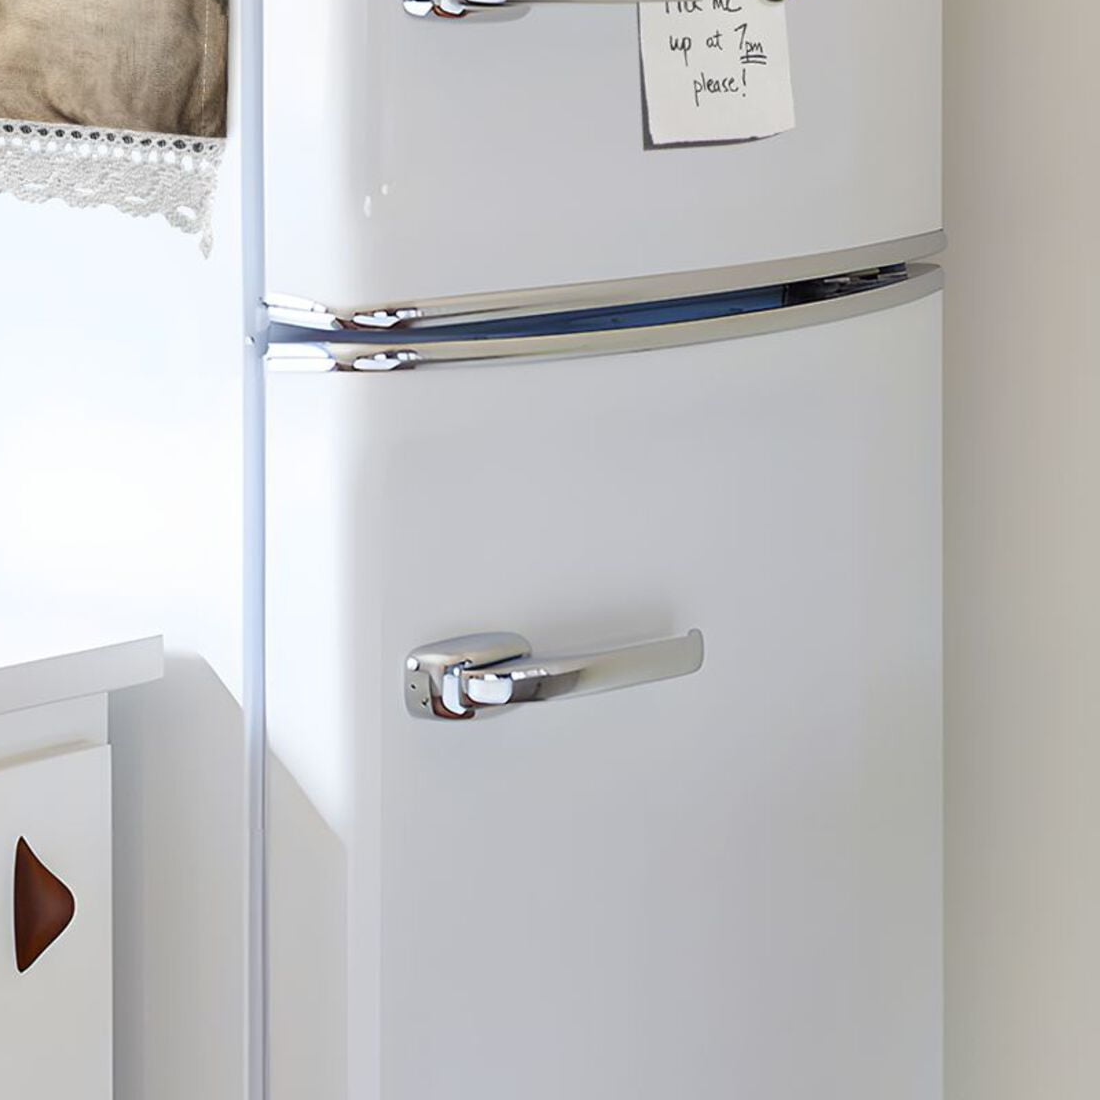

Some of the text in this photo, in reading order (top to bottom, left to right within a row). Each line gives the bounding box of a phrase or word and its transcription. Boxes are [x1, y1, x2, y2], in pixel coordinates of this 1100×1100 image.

[669, 35, 692, 67] up
[706, 29, 723, 51] at
[693, 68, 746, 107] please!
